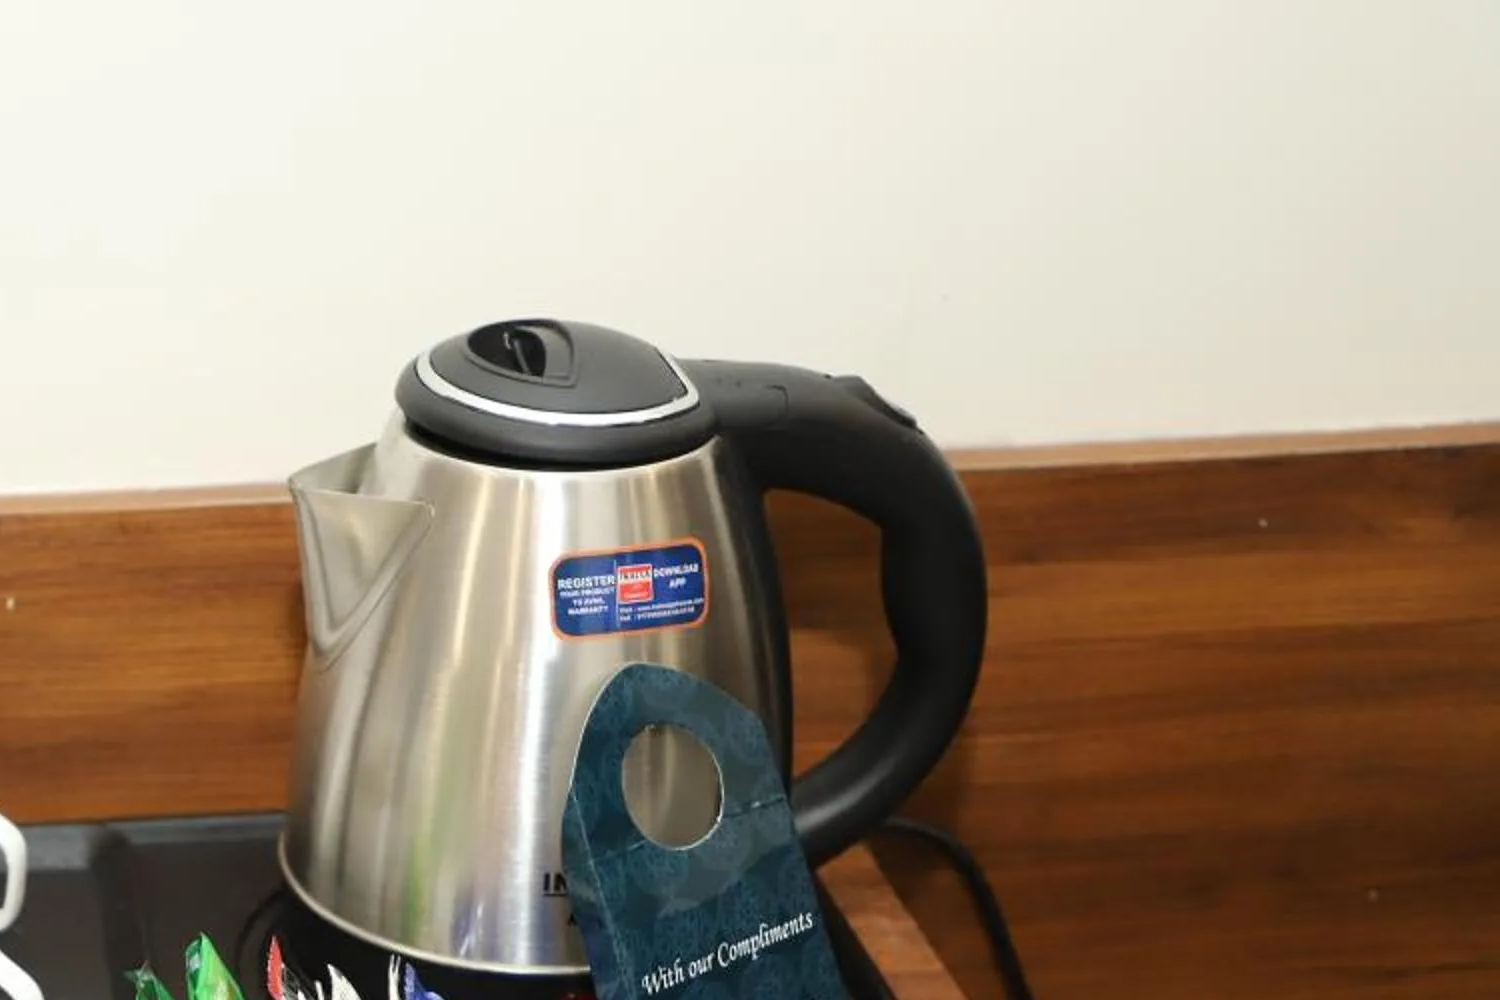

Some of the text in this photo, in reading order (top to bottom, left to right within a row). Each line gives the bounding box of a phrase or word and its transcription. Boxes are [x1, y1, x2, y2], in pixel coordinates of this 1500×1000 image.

[557, 575, 615, 590] REGISTER
[641, 911, 813, 996] With our Compliments
